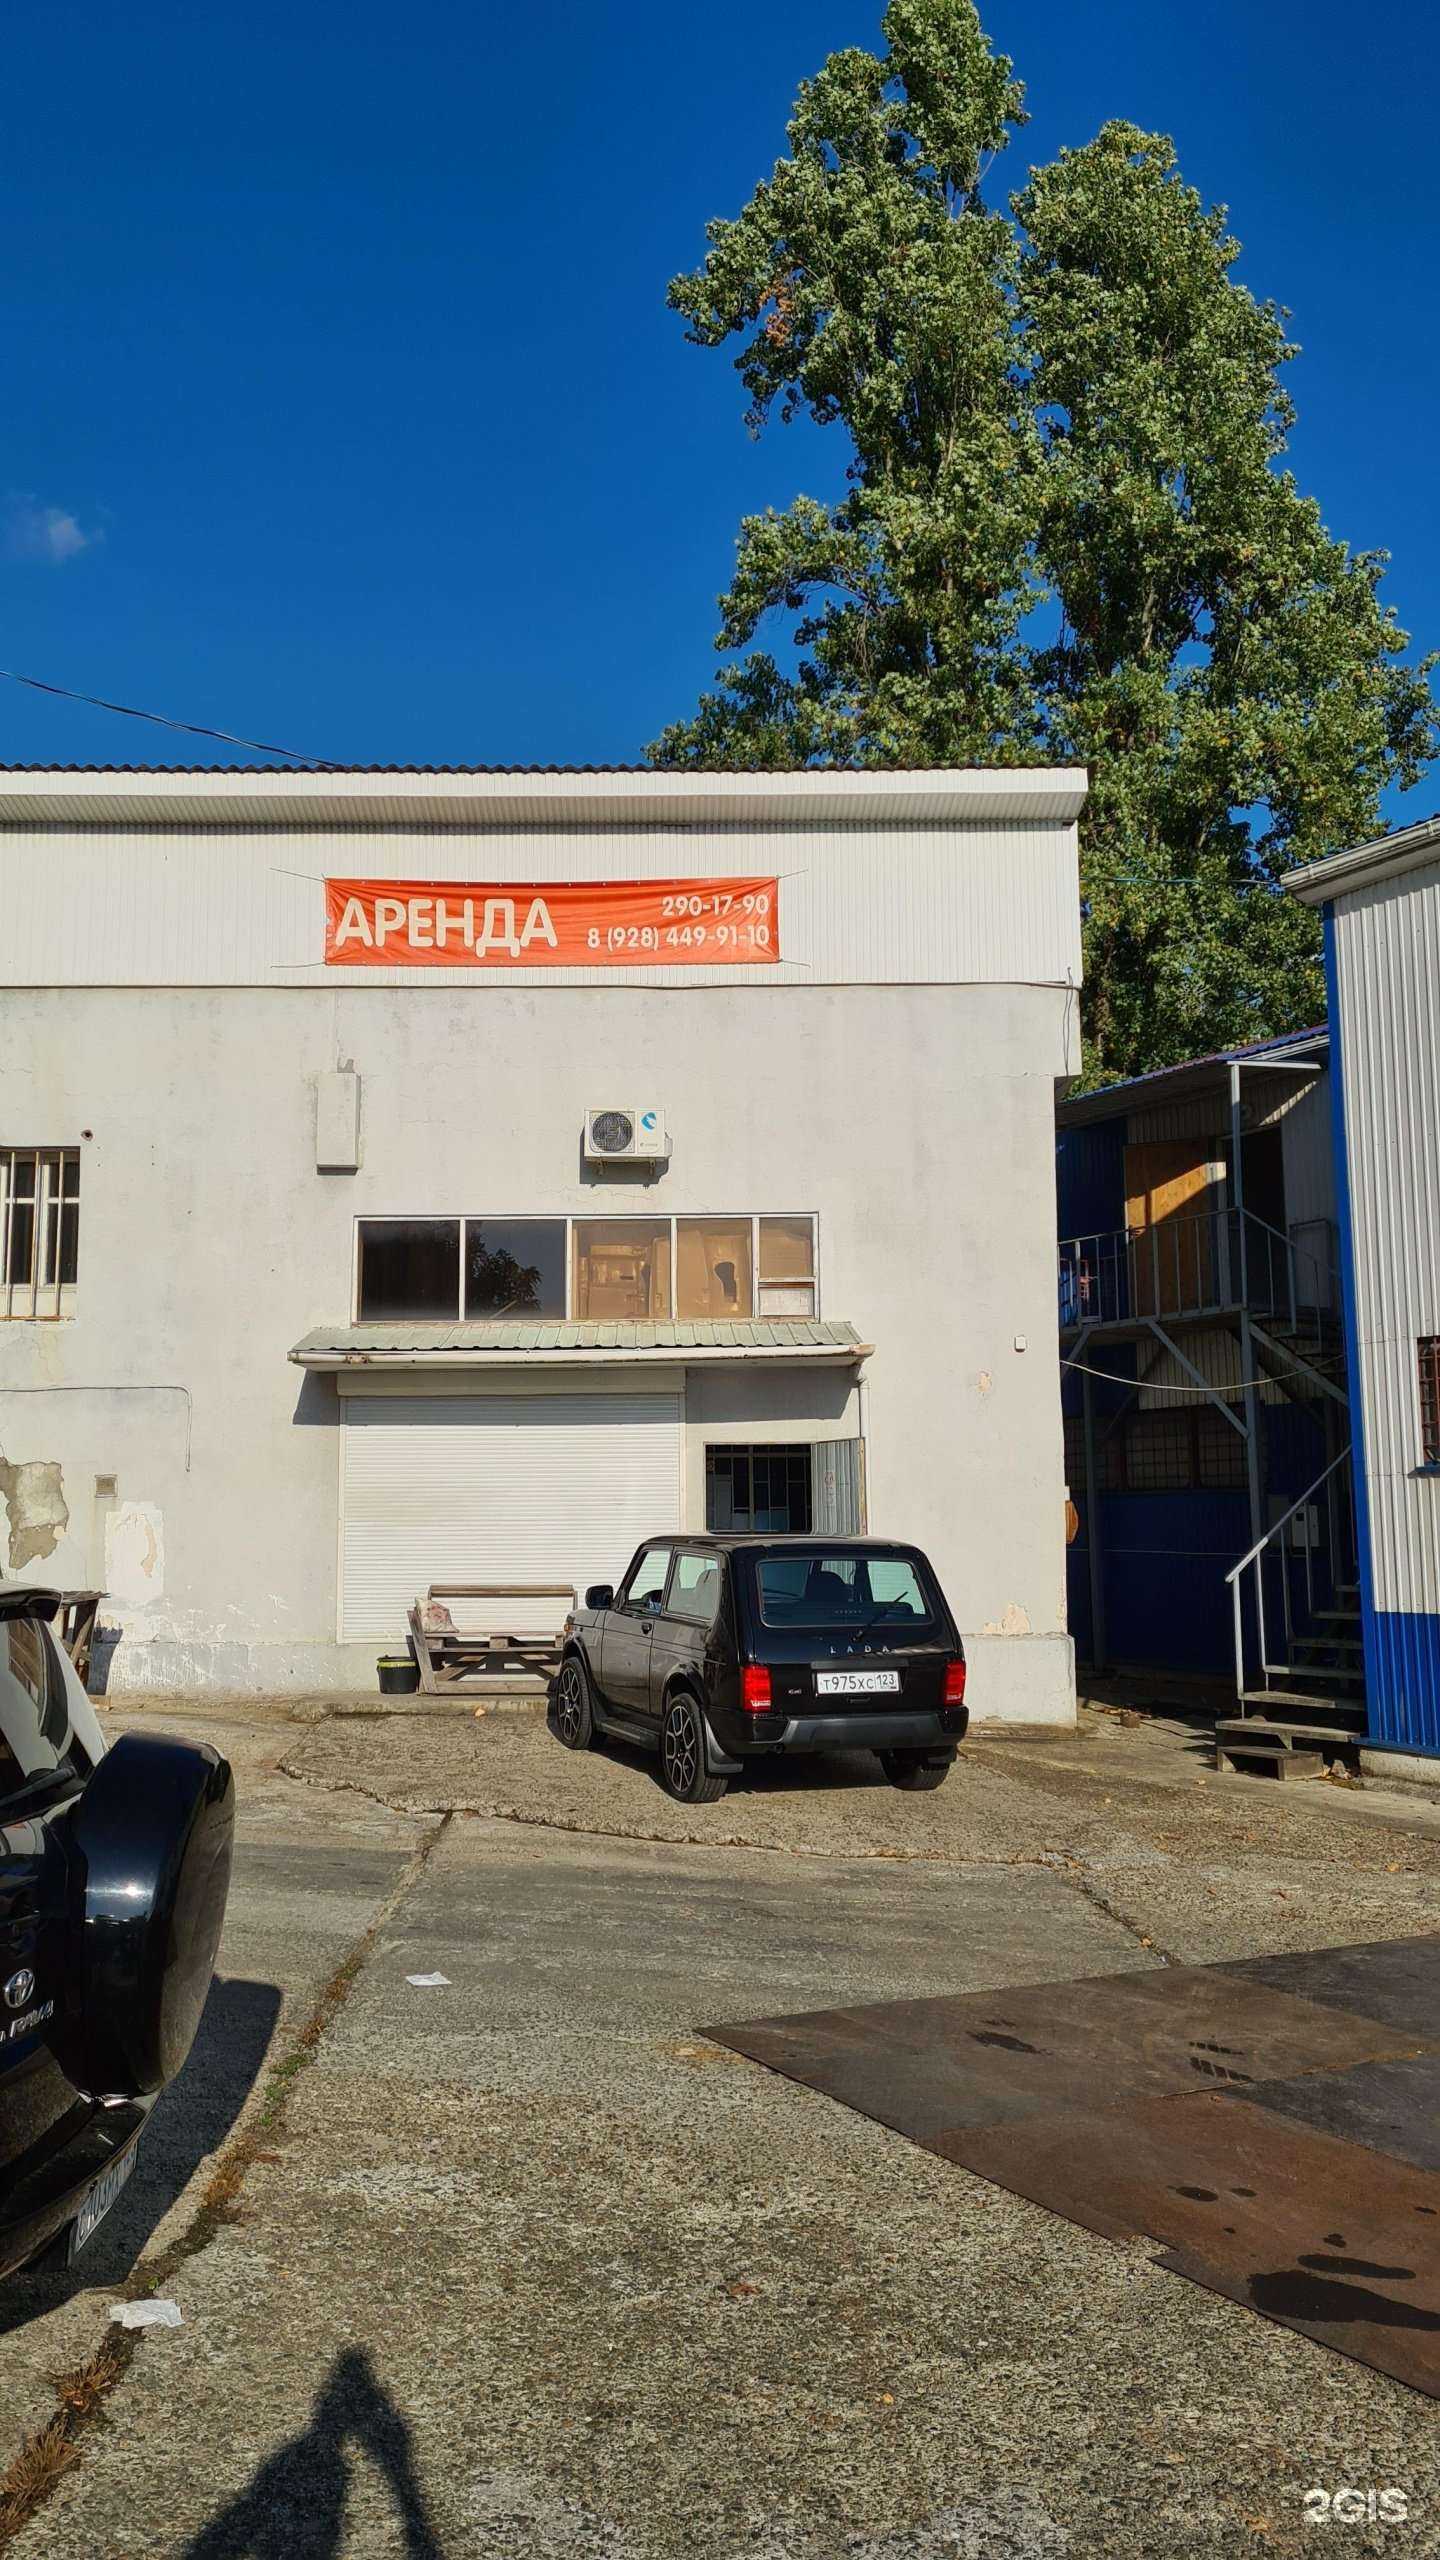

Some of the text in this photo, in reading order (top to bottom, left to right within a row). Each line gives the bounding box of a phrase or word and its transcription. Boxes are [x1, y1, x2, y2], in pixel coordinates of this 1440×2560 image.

[661, 894, 770, 917] 290-17-90
[335, 897, 559, 958] АРЕНДА
[587, 924, 771, 952] 8 (928) 449-91-10
[830, 1646, 889, 1654] LADA
